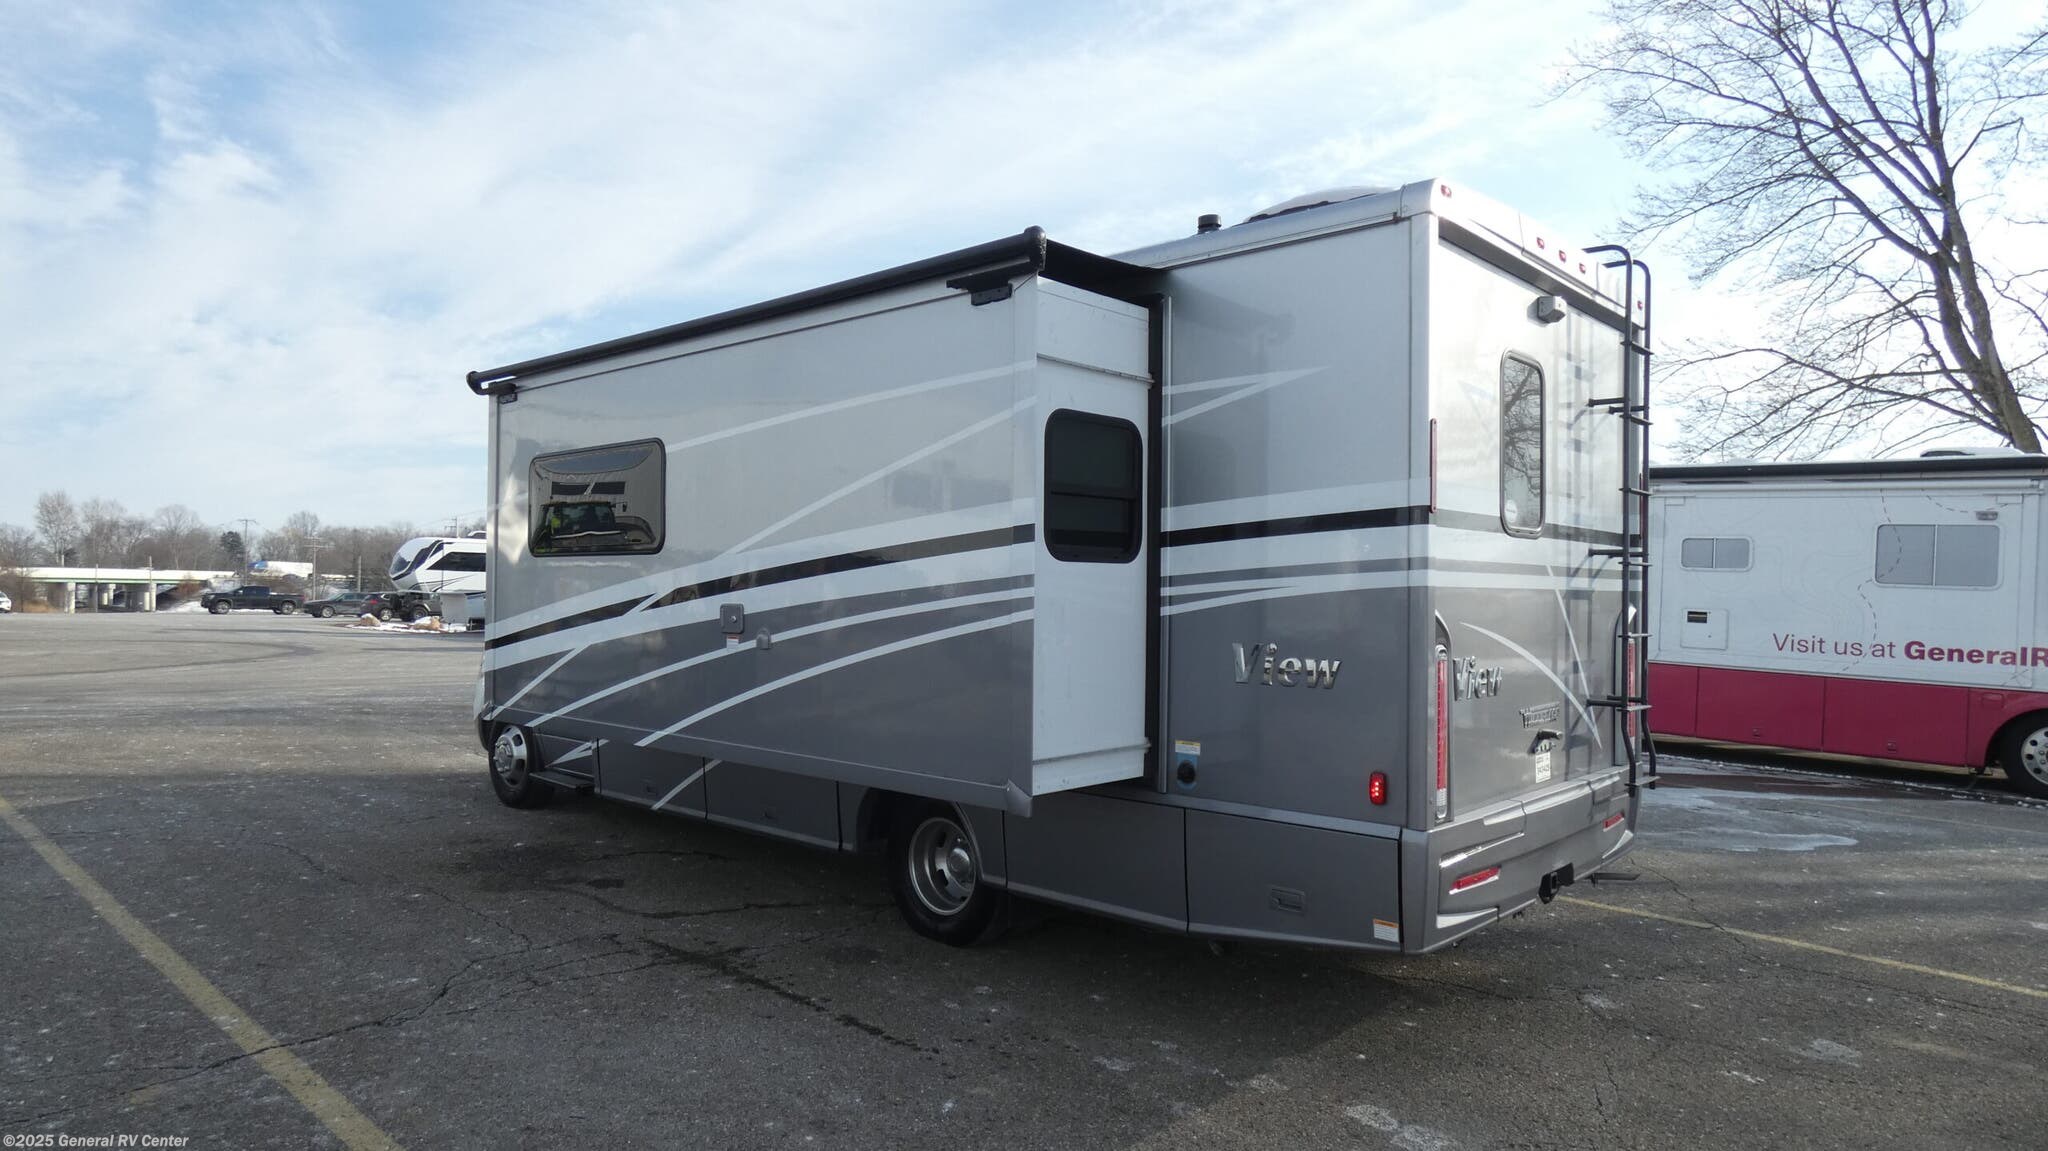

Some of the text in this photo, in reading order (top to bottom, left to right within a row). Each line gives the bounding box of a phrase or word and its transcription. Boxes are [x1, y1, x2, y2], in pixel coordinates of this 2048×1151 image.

[1232, 642, 1342, 689] View
[1773, 633, 1825, 654] Visit
[1834, 641, 1863, 656] us
[1870, 641, 1896, 658] at
[1453, 656, 1503, 701] View
